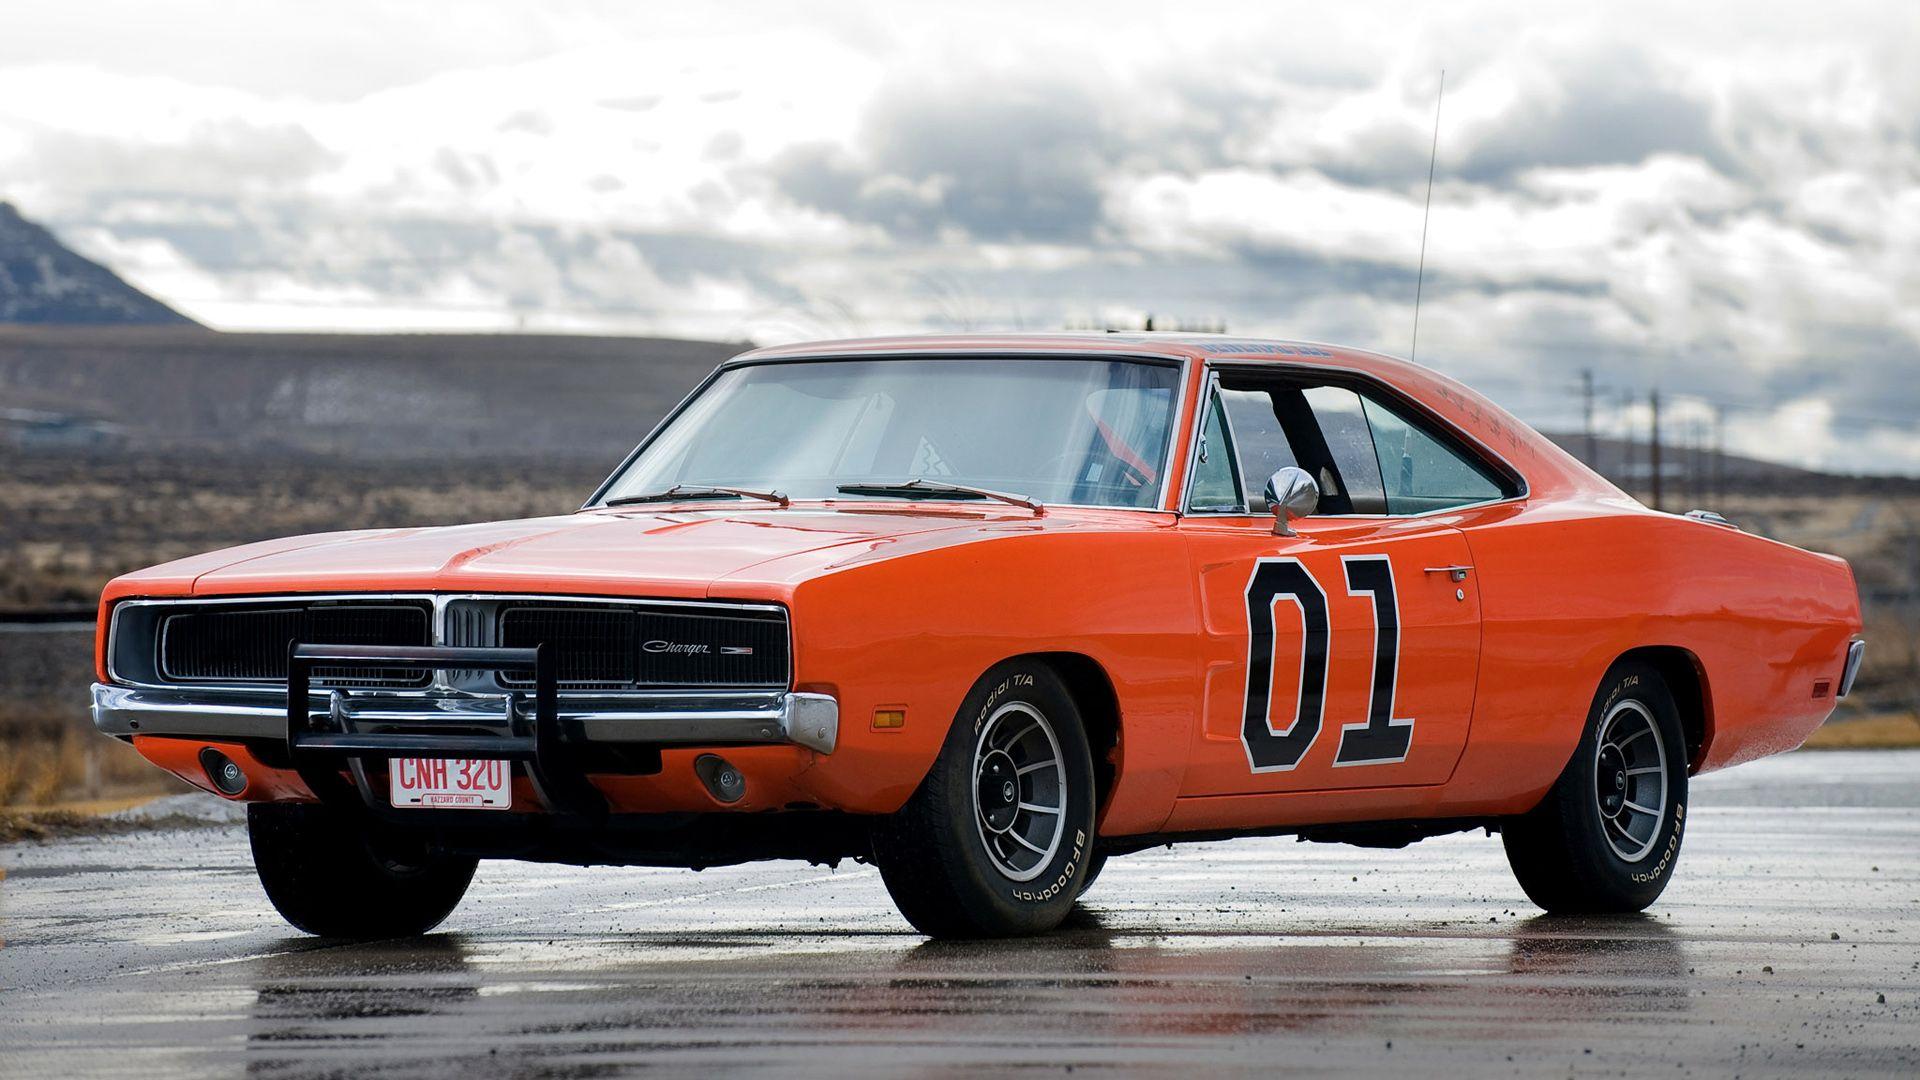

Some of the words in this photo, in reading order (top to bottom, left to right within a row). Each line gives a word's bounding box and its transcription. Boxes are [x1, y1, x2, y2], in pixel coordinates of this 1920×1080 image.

[642, 640, 711, 657] Charger
[1240, 554, 1416, 774] 01
[1013, 673, 1034, 686] T/A
[1623, 675, 1640, 688] T/A
[400, 758, 448, 789] CNH
[456, 760, 502, 790] 320
[1012, 829, 1085, 903] BFGoodrich
